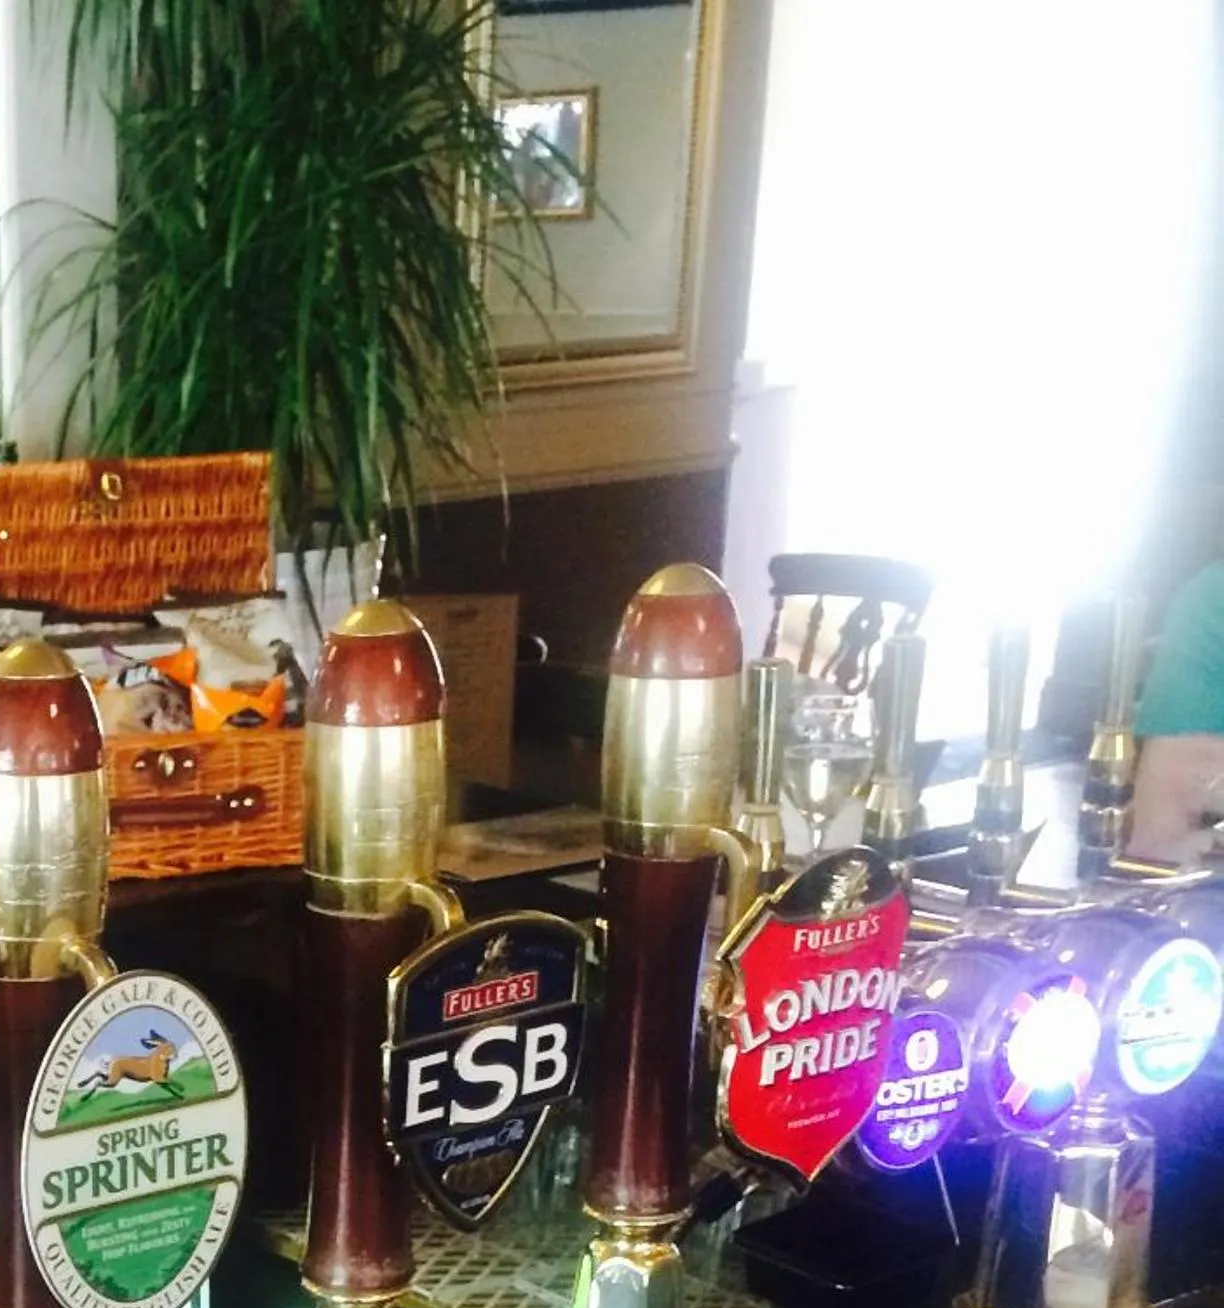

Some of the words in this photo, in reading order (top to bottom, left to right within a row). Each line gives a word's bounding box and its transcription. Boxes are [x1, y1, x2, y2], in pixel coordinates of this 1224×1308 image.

[792, 914, 880, 952] FULLER'S
[736, 966, 902, 1054] LONDON
[42, 1014, 97, 1115] GEORGE
[101, 982, 158, 1015] GALE
[402, 1022, 569, 1128] ESB
[759, 1018, 881, 1086] PRIDE
[42, 1132, 233, 1210] SPRINTER
[96, 1118, 180, 1157] SPRING
[204, 1202, 230, 1244] ALE
